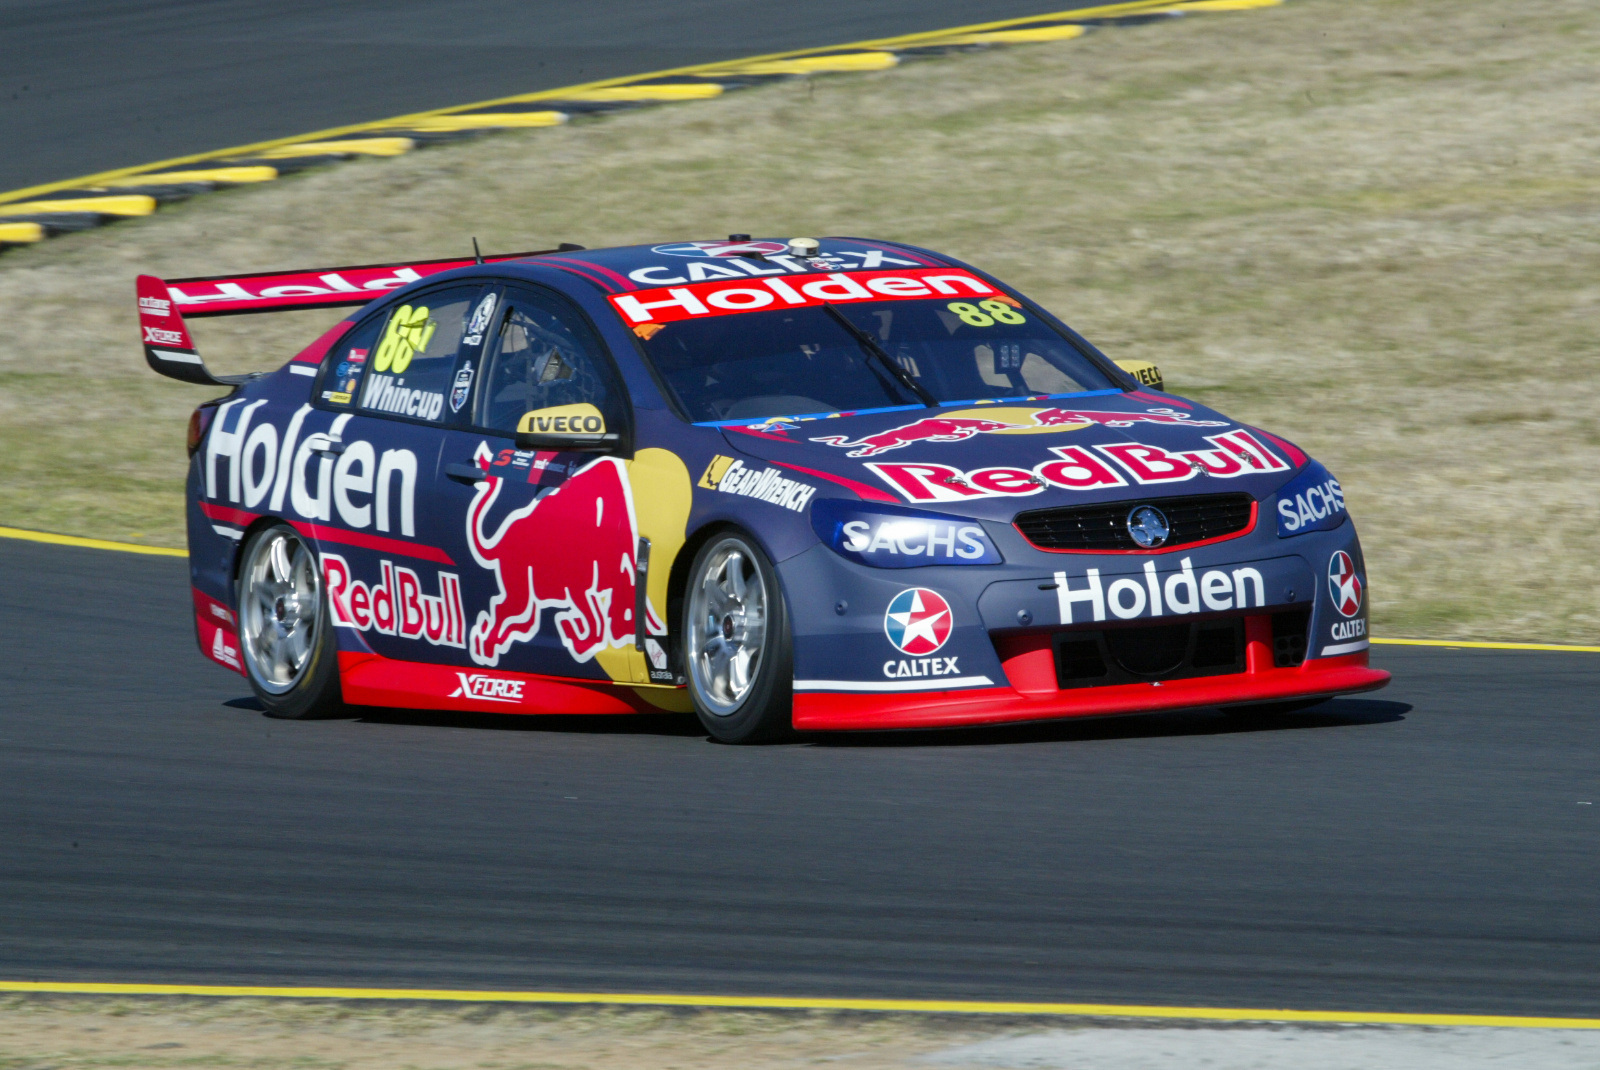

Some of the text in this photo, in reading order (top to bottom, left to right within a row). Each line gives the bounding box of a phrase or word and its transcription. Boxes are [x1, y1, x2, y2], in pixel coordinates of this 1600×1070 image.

[613, 272, 994, 323] Holden
[947, 300, 1026, 327] 88
[374, 304, 437, 374] 88
[362, 373, 443, 420] Whincup
[528, 416, 602, 432] IVECO
[205, 398, 418, 537] Holden
[1277, 479, 1345, 531] SACHS
[842, 520, 985, 560] SACHS
[1053, 556, 1265, 624] Holden
[1331, 618, 1367, 640] CALTEX
[447, 672, 526, 703] XFORCE
[882, 656, 961, 678] CALTEX
